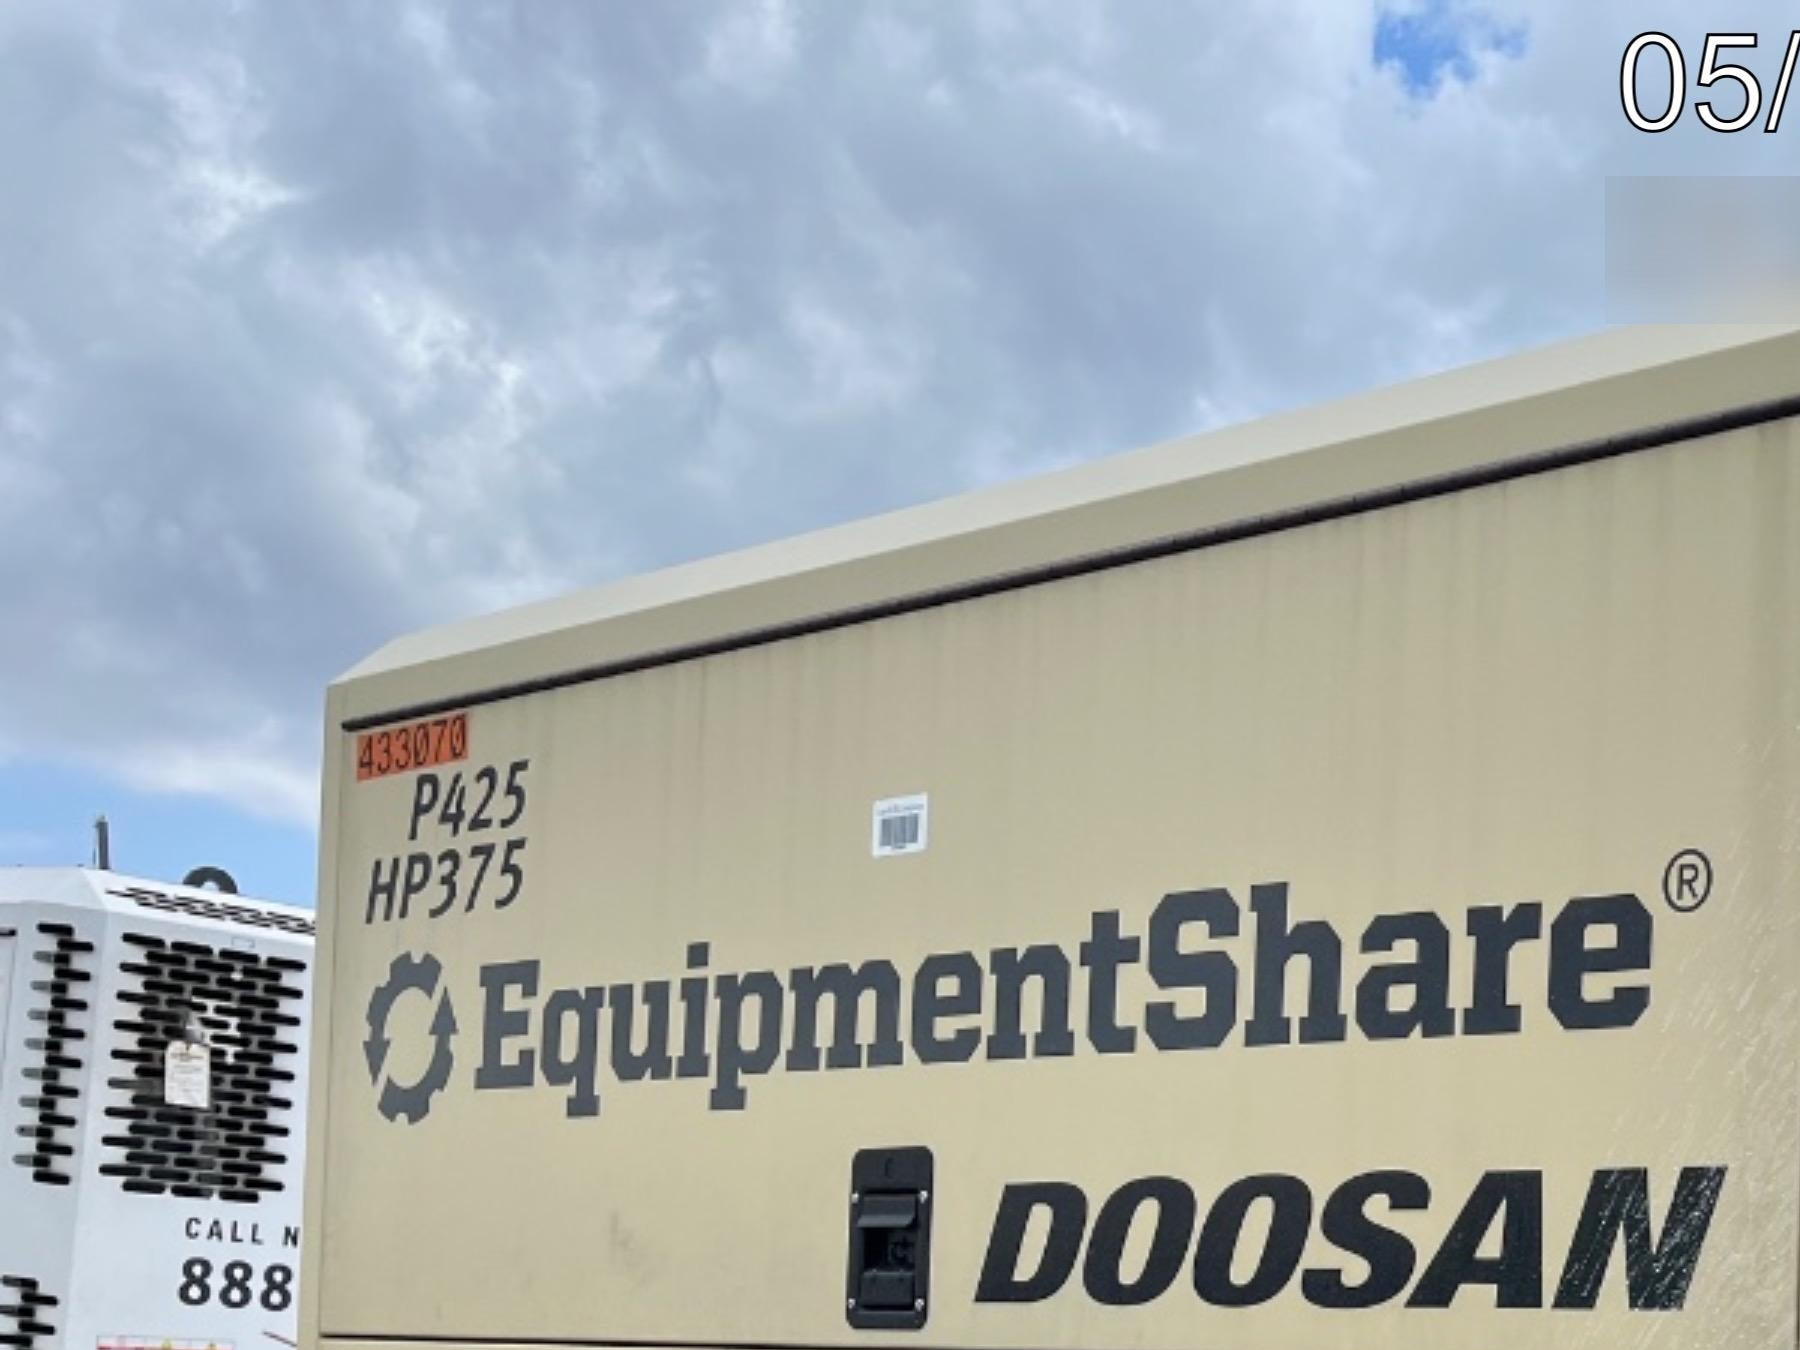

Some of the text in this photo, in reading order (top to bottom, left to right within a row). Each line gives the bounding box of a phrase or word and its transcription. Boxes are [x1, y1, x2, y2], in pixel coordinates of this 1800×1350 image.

[358, 713, 467, 776] 433070
[408, 758, 530, 841] P425
[365, 837, 528, 925] HP375
[185, 1216, 264, 1246] CALL
[973, 1165, 1729, 1312] DOOSAN
[177, 1256, 293, 1312] 888
